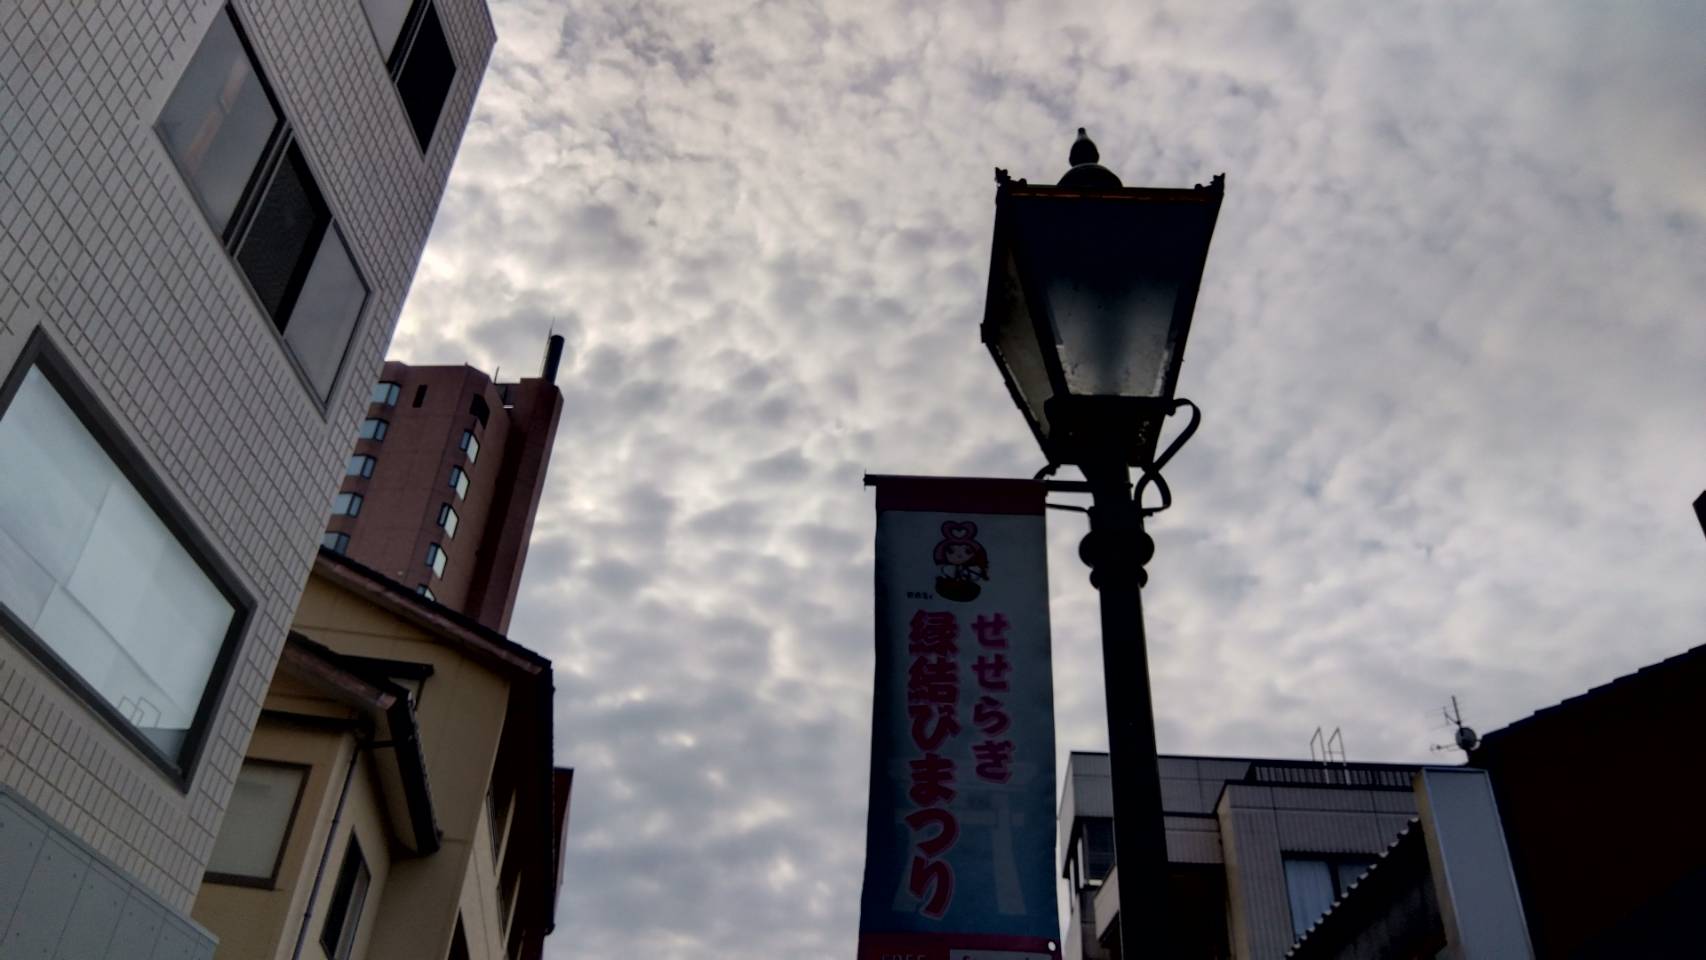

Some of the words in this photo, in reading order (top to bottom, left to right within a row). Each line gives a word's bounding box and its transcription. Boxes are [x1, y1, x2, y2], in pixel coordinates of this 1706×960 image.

[907, 609, 959, 919] 縁結びまつり
[972, 612, 1014, 781] せせらぎ
